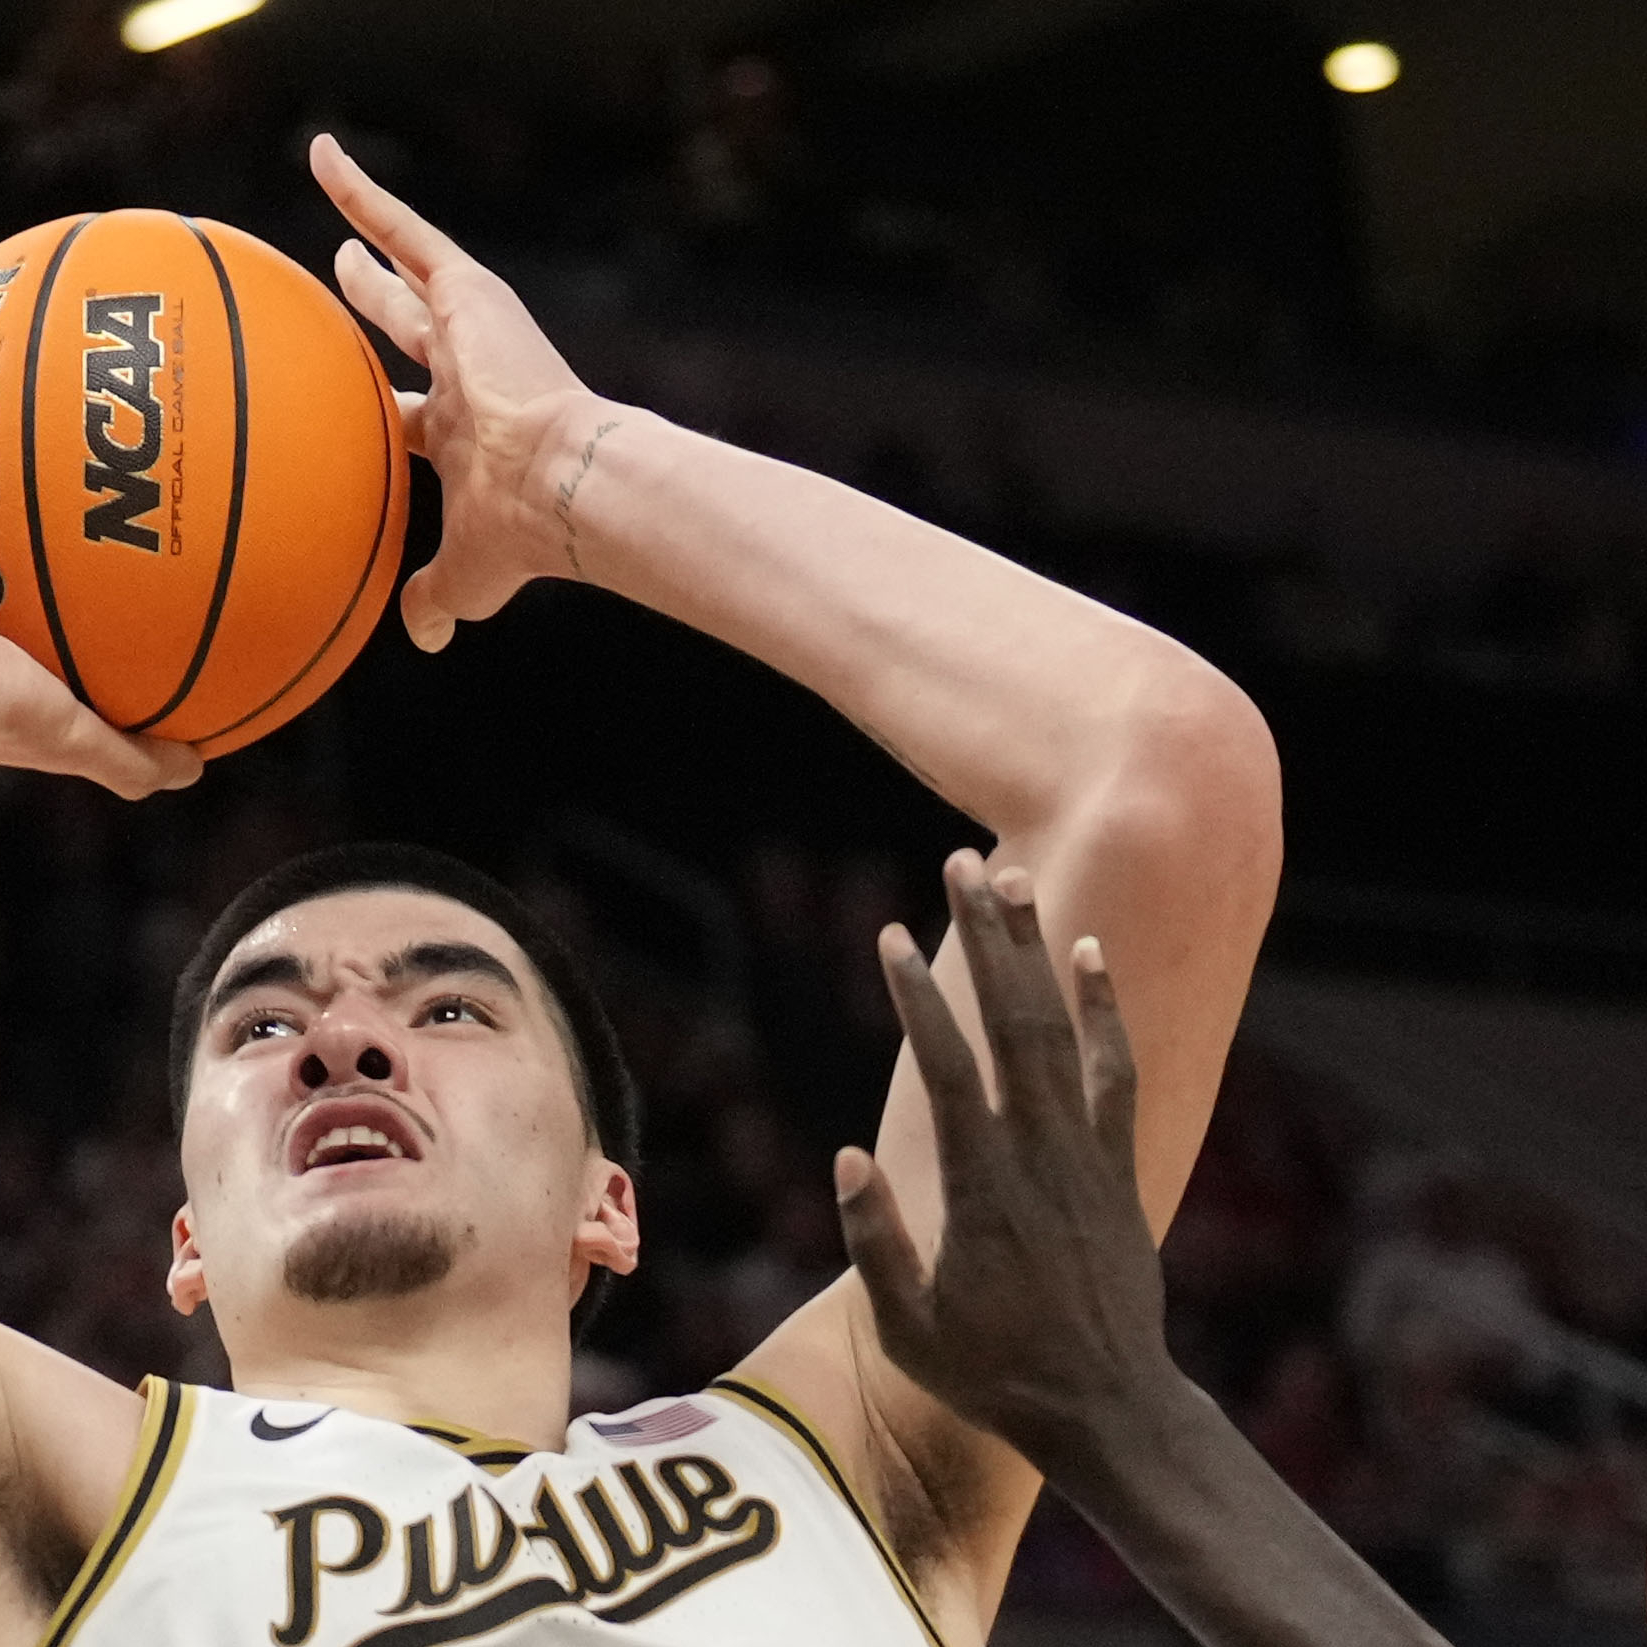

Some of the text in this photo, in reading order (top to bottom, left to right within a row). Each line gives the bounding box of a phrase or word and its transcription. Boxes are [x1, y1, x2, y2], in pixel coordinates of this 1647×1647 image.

[82, 291, 165, 556] NCAA
[169, 297, 185, 556] OFFICIAL GAME BALL
